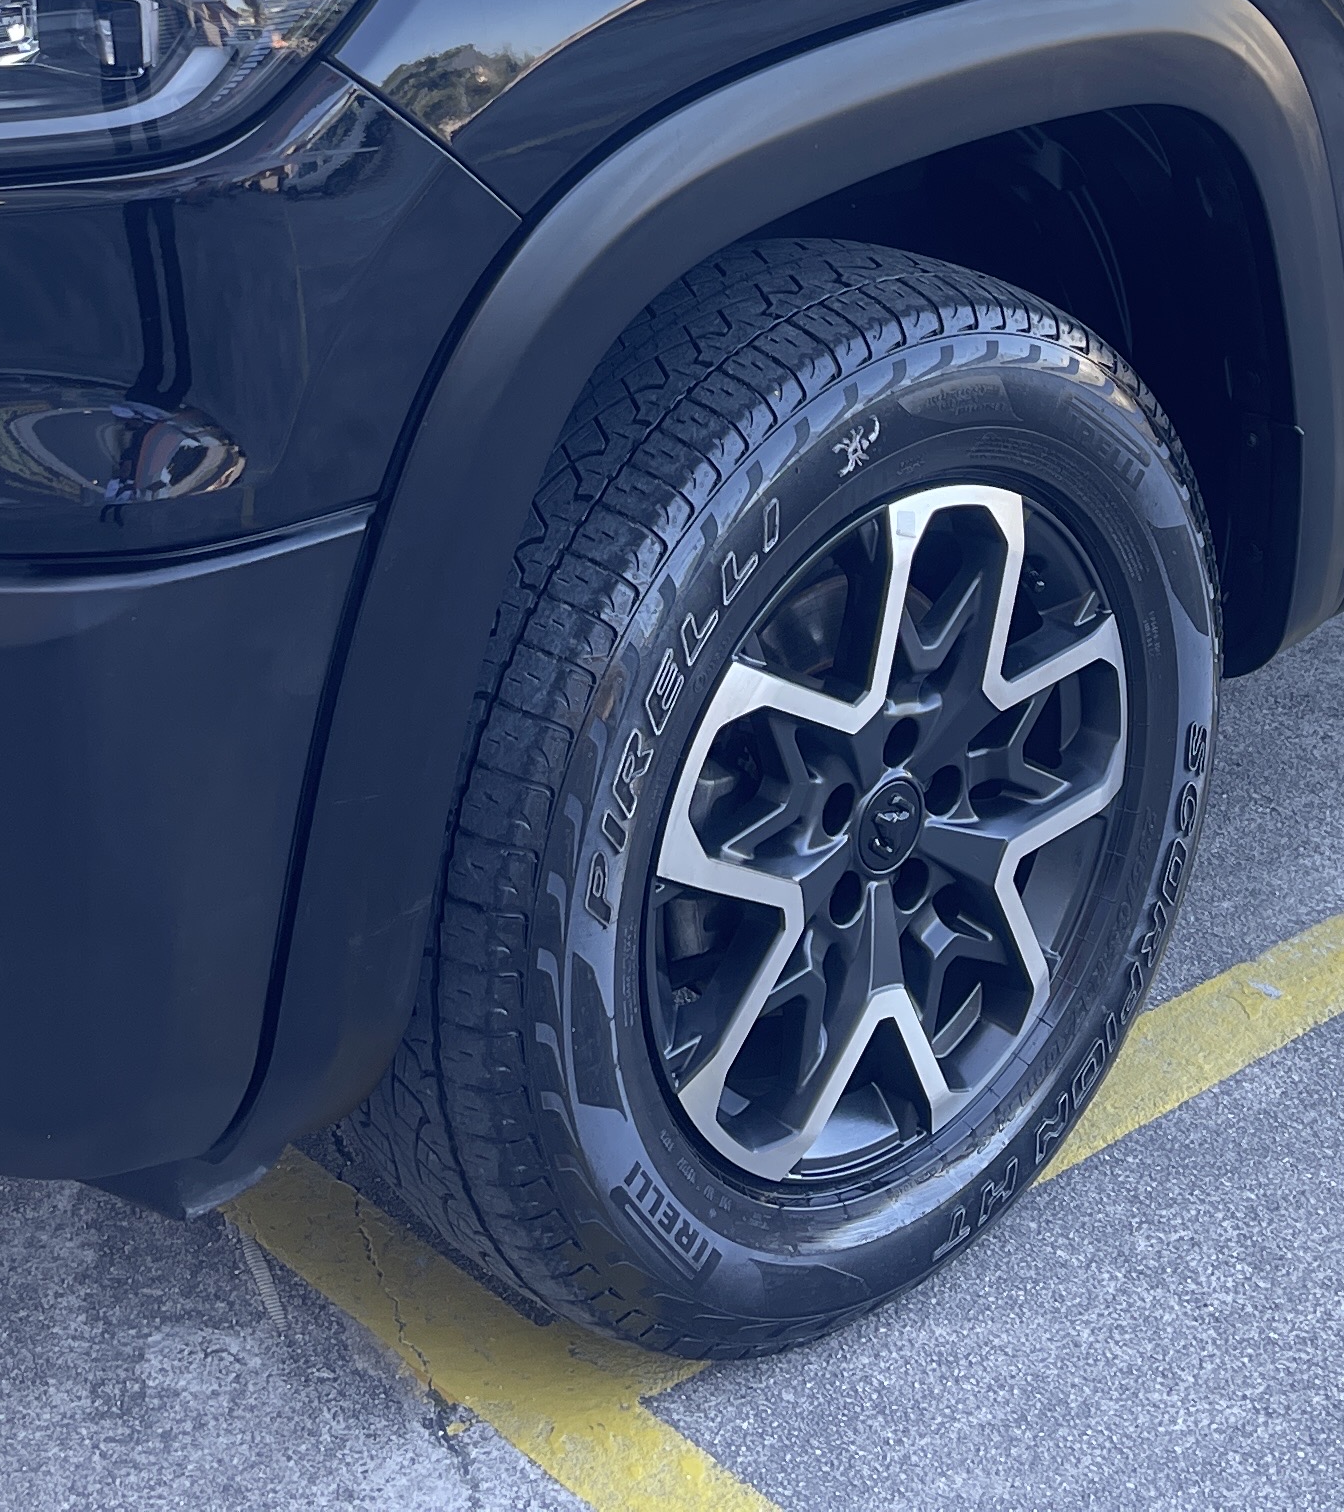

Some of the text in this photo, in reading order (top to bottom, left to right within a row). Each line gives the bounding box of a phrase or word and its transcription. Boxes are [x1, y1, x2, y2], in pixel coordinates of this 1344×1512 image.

[584, 497, 780, 930] PIRELLI
[1034, 720, 1208, 1165] SCORPION
[609, 1160, 723, 1291] PIRELLI
[932, 1155, 1019, 1263] HT
